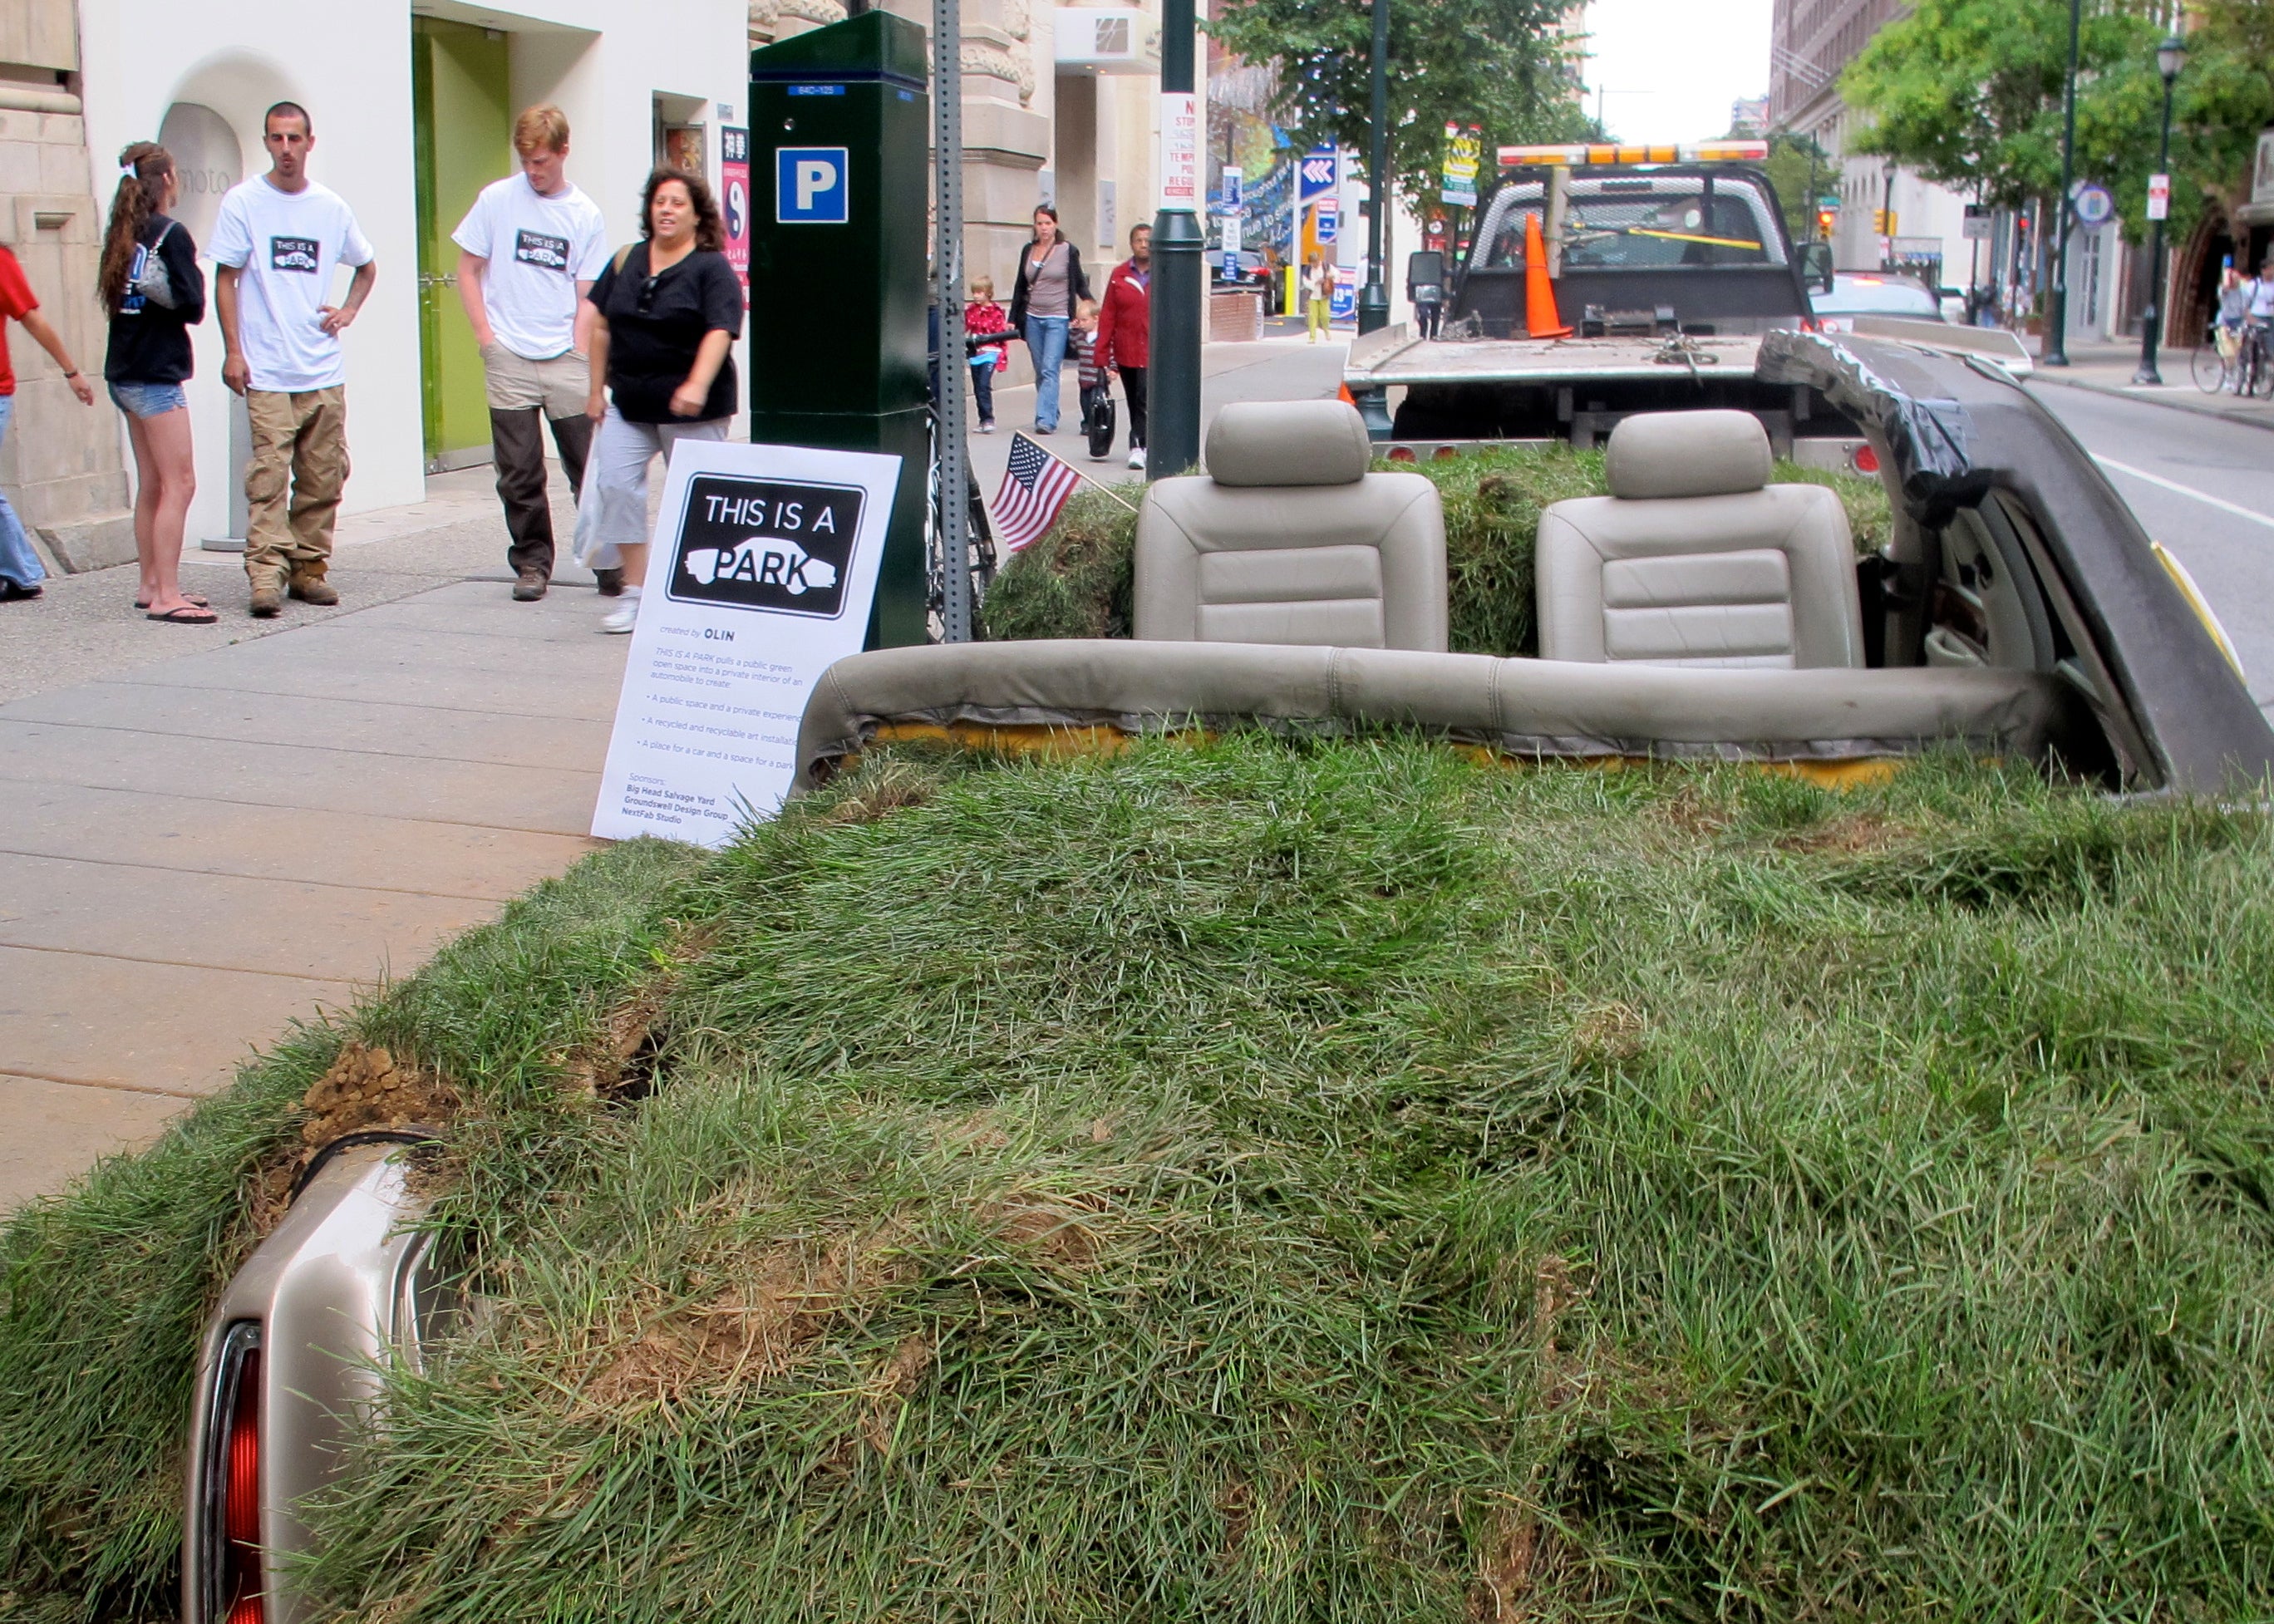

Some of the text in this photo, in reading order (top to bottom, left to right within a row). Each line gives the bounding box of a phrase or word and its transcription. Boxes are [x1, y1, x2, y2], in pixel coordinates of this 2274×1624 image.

[796, 160, 837, 210] P
[706, 495, 835, 534] THIS IS A
[714, 549, 809, 587] PARK
[660, 626, 736, 642] created by OLIN
[656, 647, 673, 657] THIS
[675, 650, 683, 658] IS
[693, 652, 715, 662] PARK
[716, 656, 735, 665] pulls
[743, 660, 768, 669] public
[770, 663, 792, 672] green
[651, 671, 693, 684] automobile
[696, 677, 704, 685] to
[653, 661, 672, 670] open
[674, 663, 696, 672] space
[698, 665, 714, 674] into
[721, 668, 750, 679] private
[751, 672, 780, 683] interior
[782, 676, 791, 684] of
[659, 696, 683, 705] public
[686, 701, 706, 710] space
[709, 703, 725, 711] and
[733, 706, 761, 717] private
[763, 711, 801, 722] experienc
[655, 718, 687, 730] recycled
[689, 724, 704, 732] and
[706, 726, 745, 738] recyclable
[747, 732, 759, 741] art
[760, 735, 797, 746] installatio
[650, 741, 671, 751] place
[672, 744, 684, 752] for
[706, 750, 721, 759] and
[731, 754, 754, 765] space
[756, 756, 767, 766] for
[627, 784, 715, 805] Big Head Salvage Yard
[622, 807, 682, 824] NextFab Studio
[624, 795, 728, 821] Groundswell Design Group
